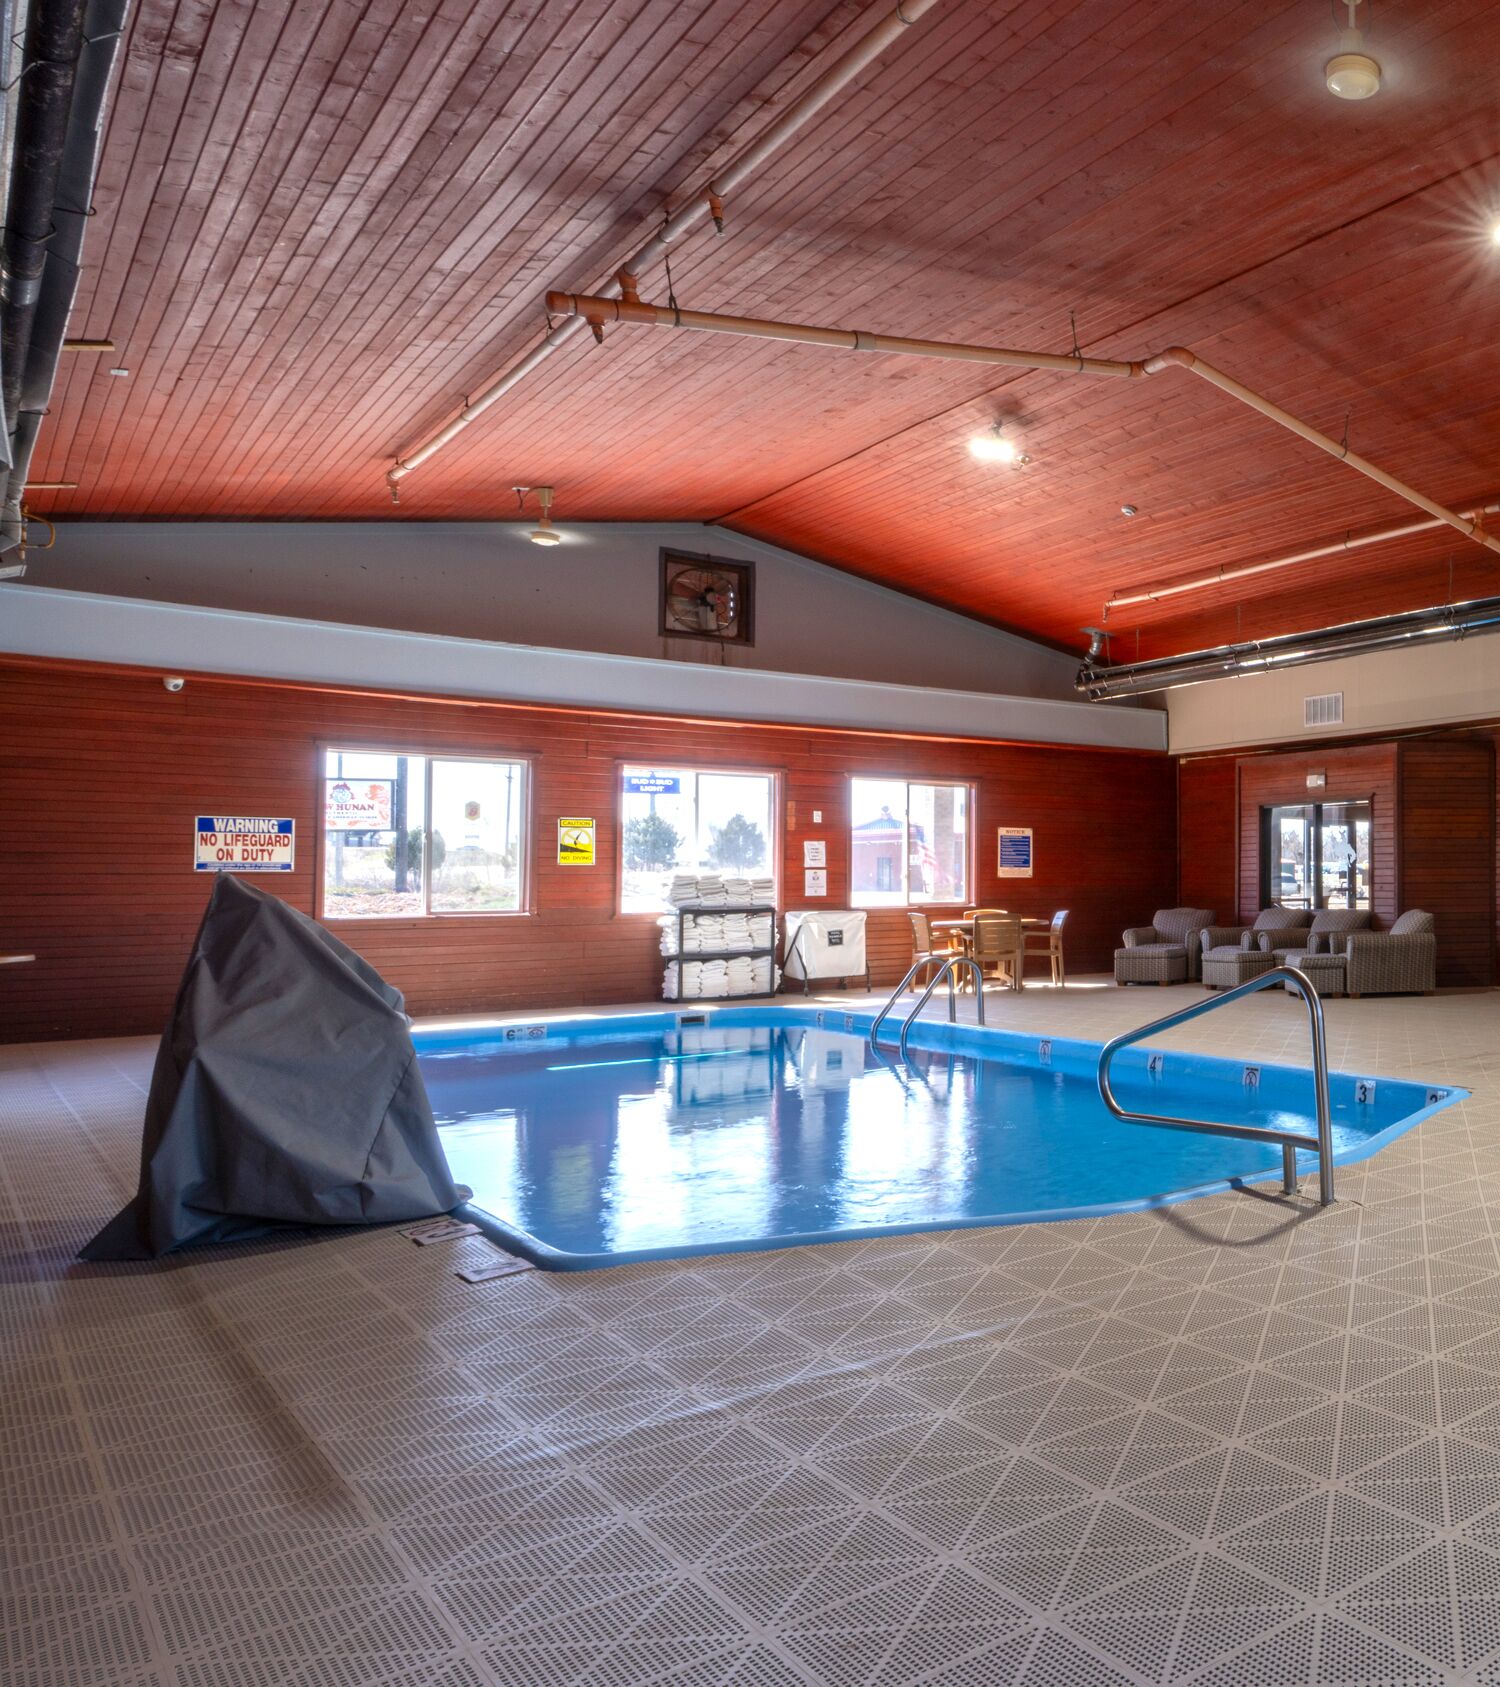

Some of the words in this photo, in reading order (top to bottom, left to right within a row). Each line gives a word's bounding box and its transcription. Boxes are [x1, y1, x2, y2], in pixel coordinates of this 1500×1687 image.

[336, 803, 375, 811] HUNAN
[213, 818, 279, 833] WARNING
[200, 833, 218, 847] NO
[224, 834, 290, 848] LIFEGUARD
[216, 848, 234, 861] ON
[241, 849, 274, 862] DUTY
[1358, 1084, 1367, 1103] 3
